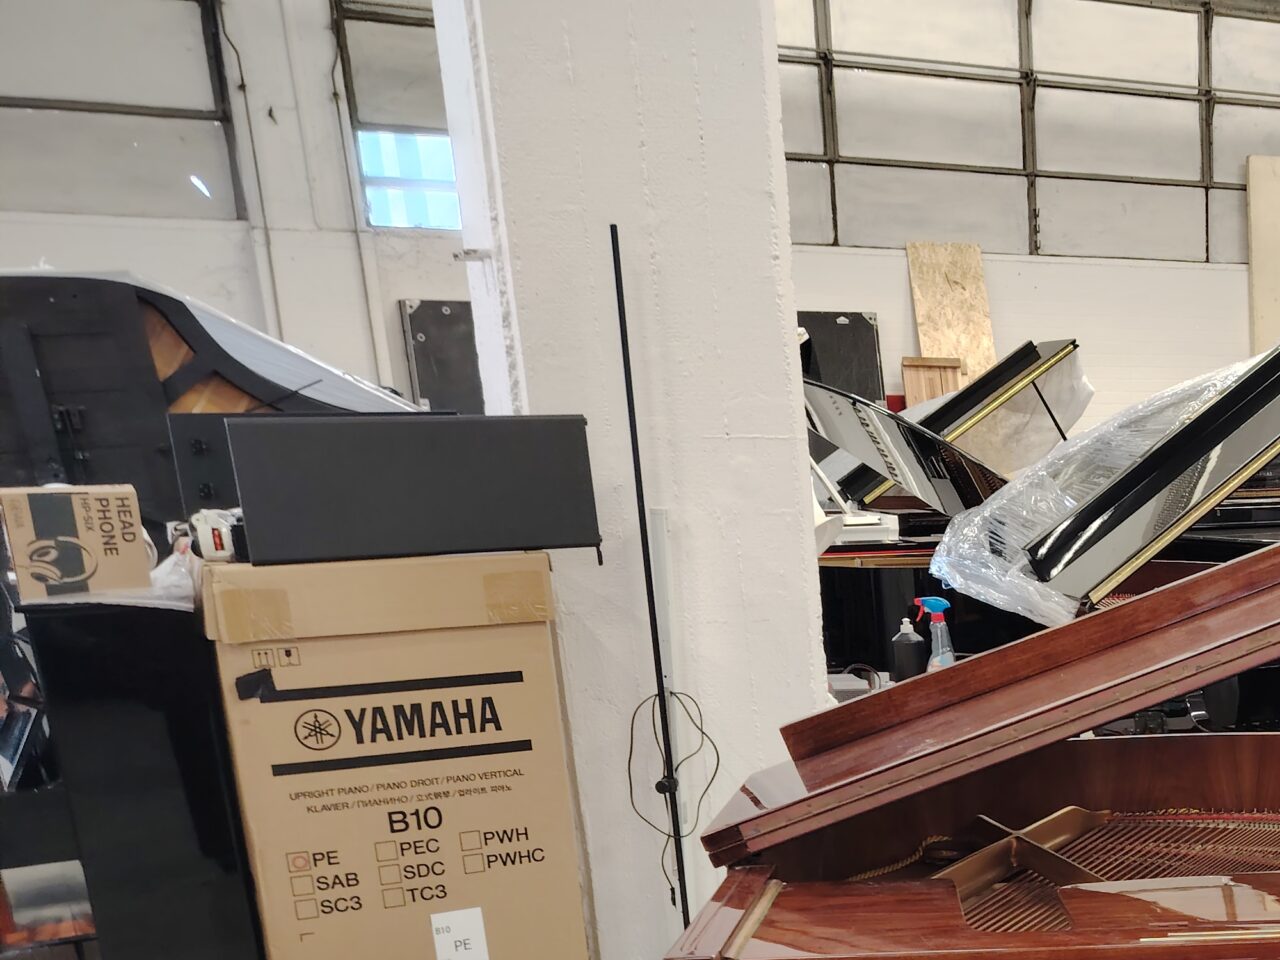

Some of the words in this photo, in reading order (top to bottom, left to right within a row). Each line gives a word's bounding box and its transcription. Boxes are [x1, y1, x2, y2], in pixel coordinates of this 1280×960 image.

[95, 497, 119, 557] PHONE
[115, 497, 137, 543] HEAD
[344, 696, 502, 744] YAMAHA
[289, 788, 335, 801] UPRIGHT
[338, 785, 369, 796] PIANO
[376, 781, 408, 791] PIANO
[410, 777, 439, 788] DROIT
[446, 774, 476, 784] PIANO
[478, 768, 525, 780] VERTICAL
[306, 802, 349, 814] KLAVIER
[388, 806, 443, 834] B10
[312, 850, 340, 868] PE
[400, 839, 441, 857] PEC
[483, 827, 529, 847] PWH
[316, 872, 360, 891] SAB
[403, 862, 446, 880] SDC
[486, 848, 546, 869] PWHC
[320, 896, 363, 915] SC3
[406, 884, 448, 903] TC3
[435, 925, 451, 936] B10
[454, 938, 473, 952] PE
